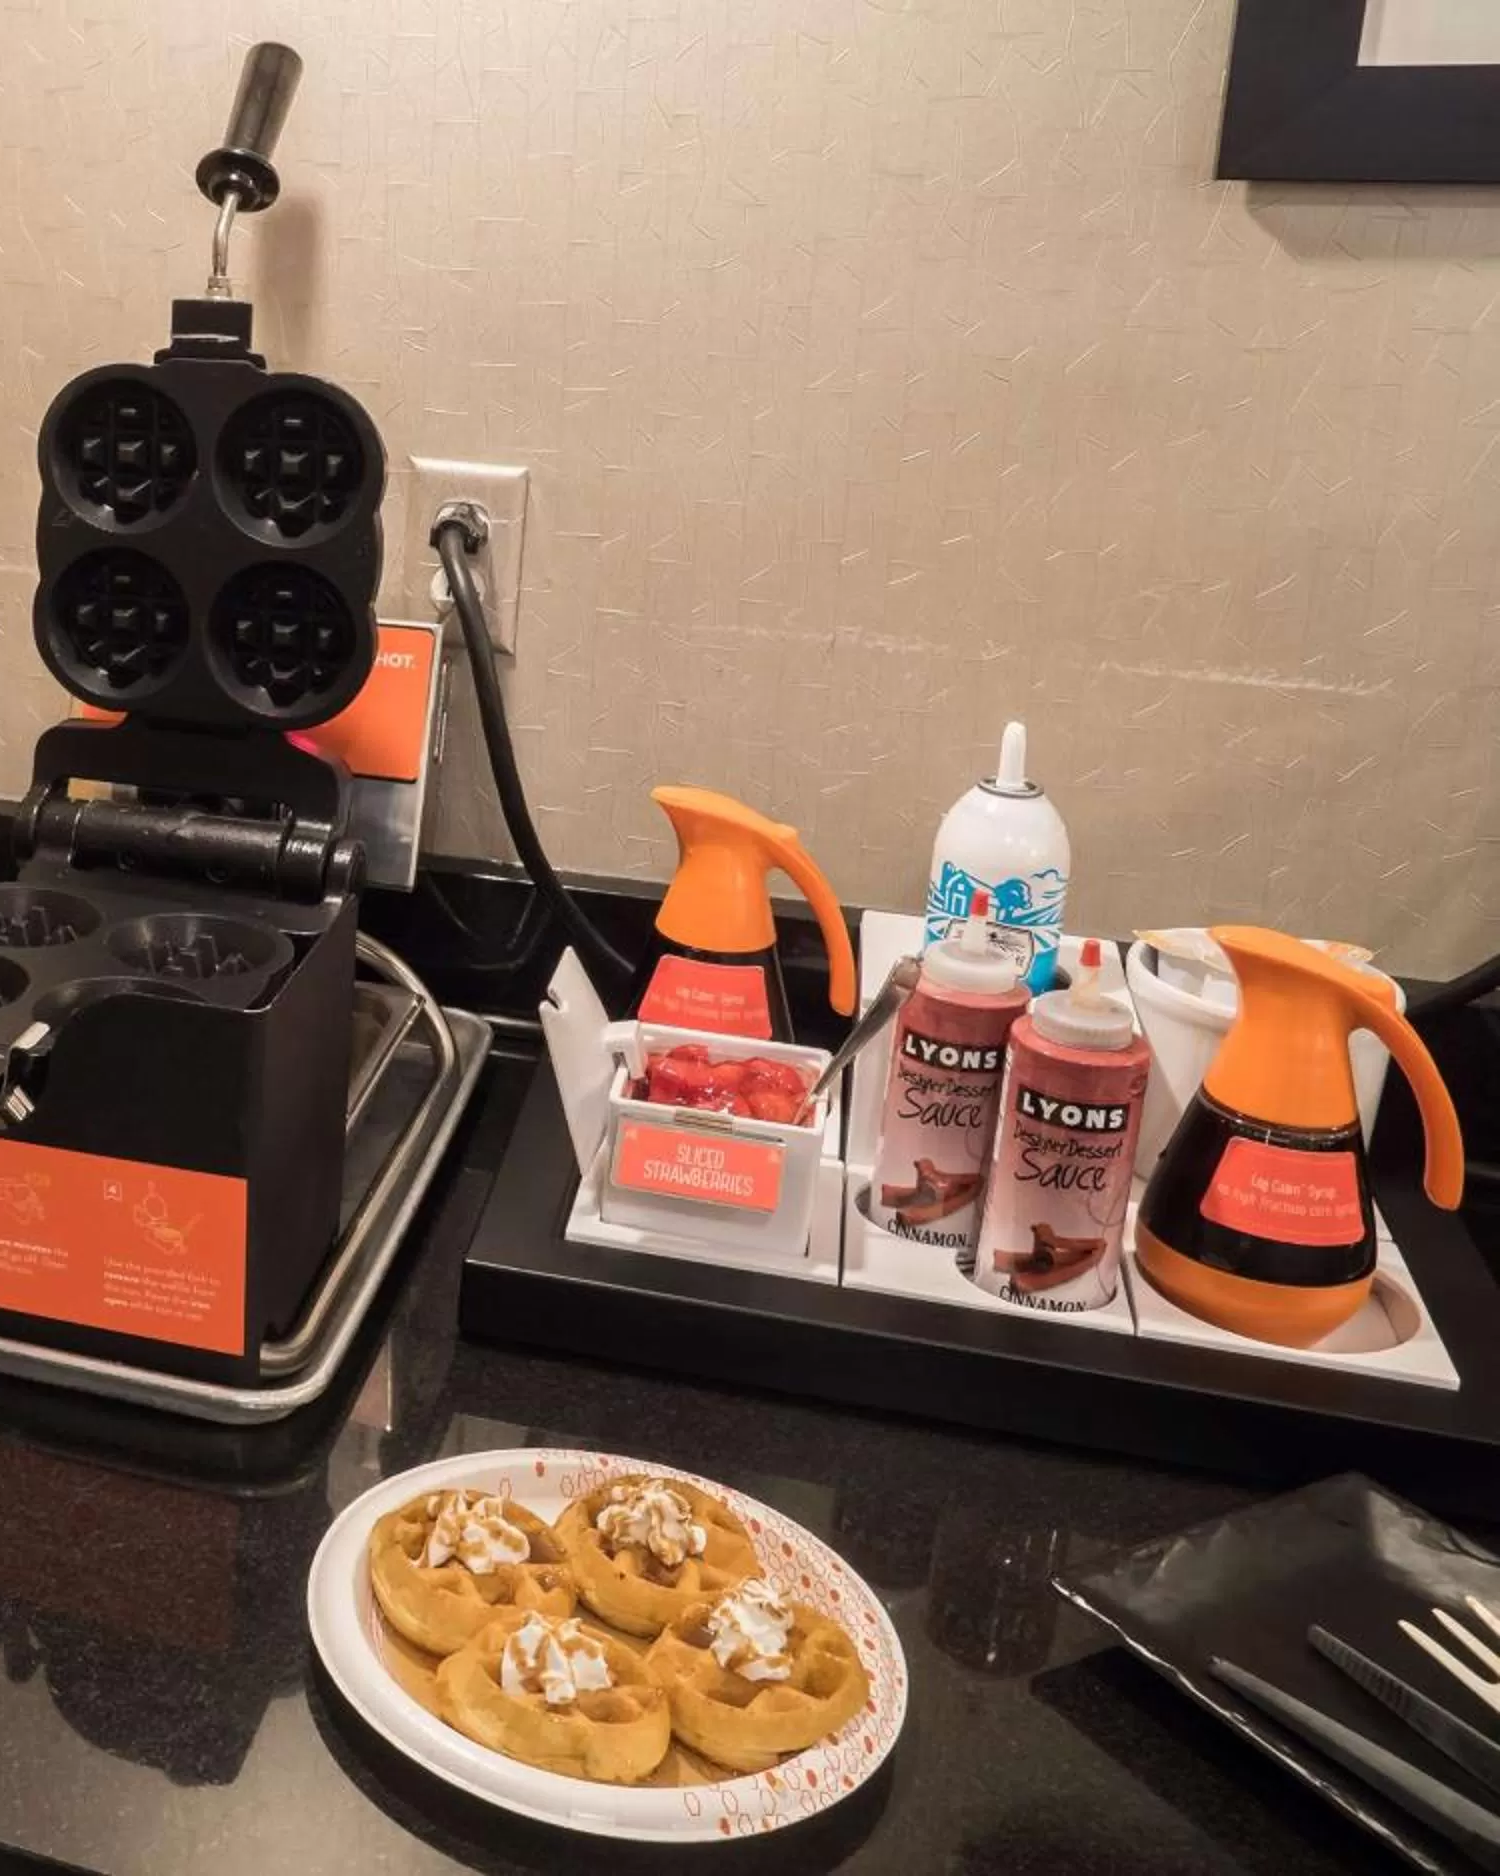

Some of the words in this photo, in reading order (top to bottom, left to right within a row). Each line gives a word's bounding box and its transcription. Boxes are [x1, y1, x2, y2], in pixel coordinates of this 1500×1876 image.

[904, 1033, 998, 1070] LYONS
[898, 1086, 982, 1129] Sauce
[1021, 1092, 1124, 1129] LYONS
[676, 1143, 725, 1170] SLICED
[1013, 1148, 1107, 1191] Sauce
[643, 1158, 754, 1197] STRAWBERRIES
